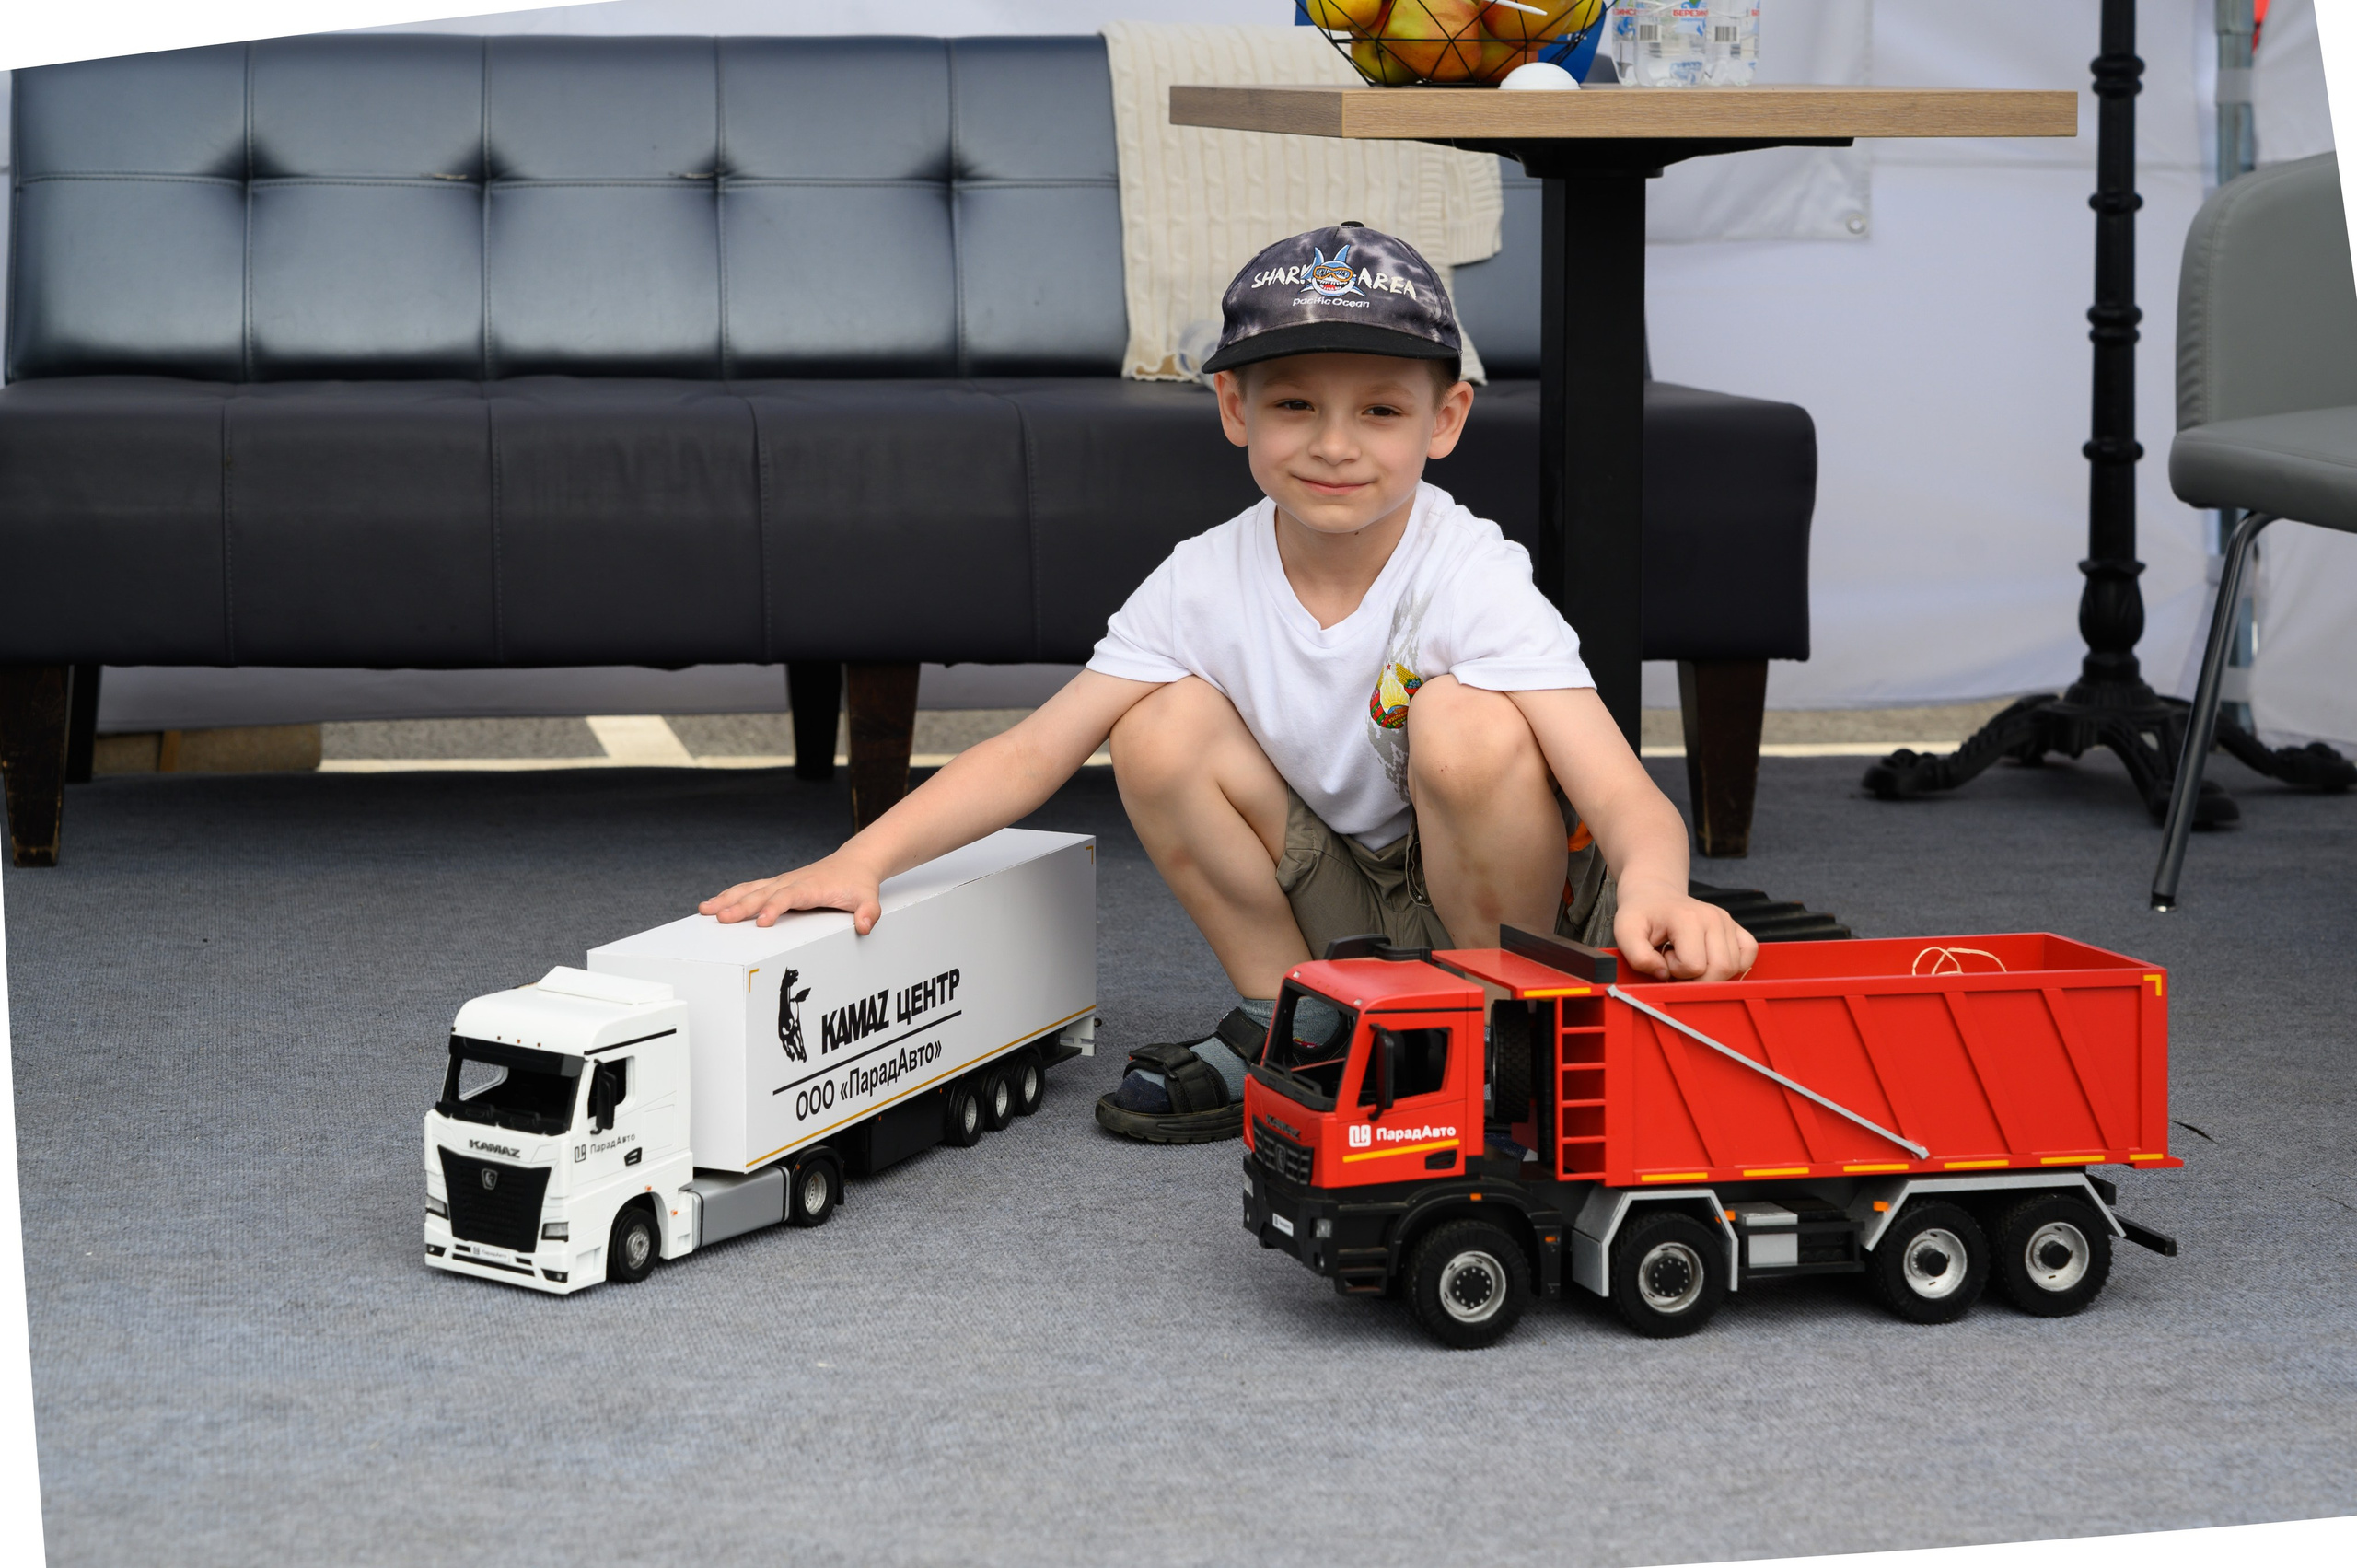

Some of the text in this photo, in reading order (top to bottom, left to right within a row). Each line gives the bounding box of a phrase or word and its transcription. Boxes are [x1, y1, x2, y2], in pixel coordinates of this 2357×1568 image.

[1251, 265, 1417, 300] SHARK AREA
[1293, 297, 1370, 308] pacific Ocean
[821, 967, 960, 1055] KAMAZ ЦЕНТР
[795, 1040, 942, 1121] ООО «ПарадАвто»
[590, 1133, 636, 1155] ПарадАвто
[1376, 1124, 1457, 1143] ПарадАвто
[469, 1139, 521, 1159] KAMAZ
